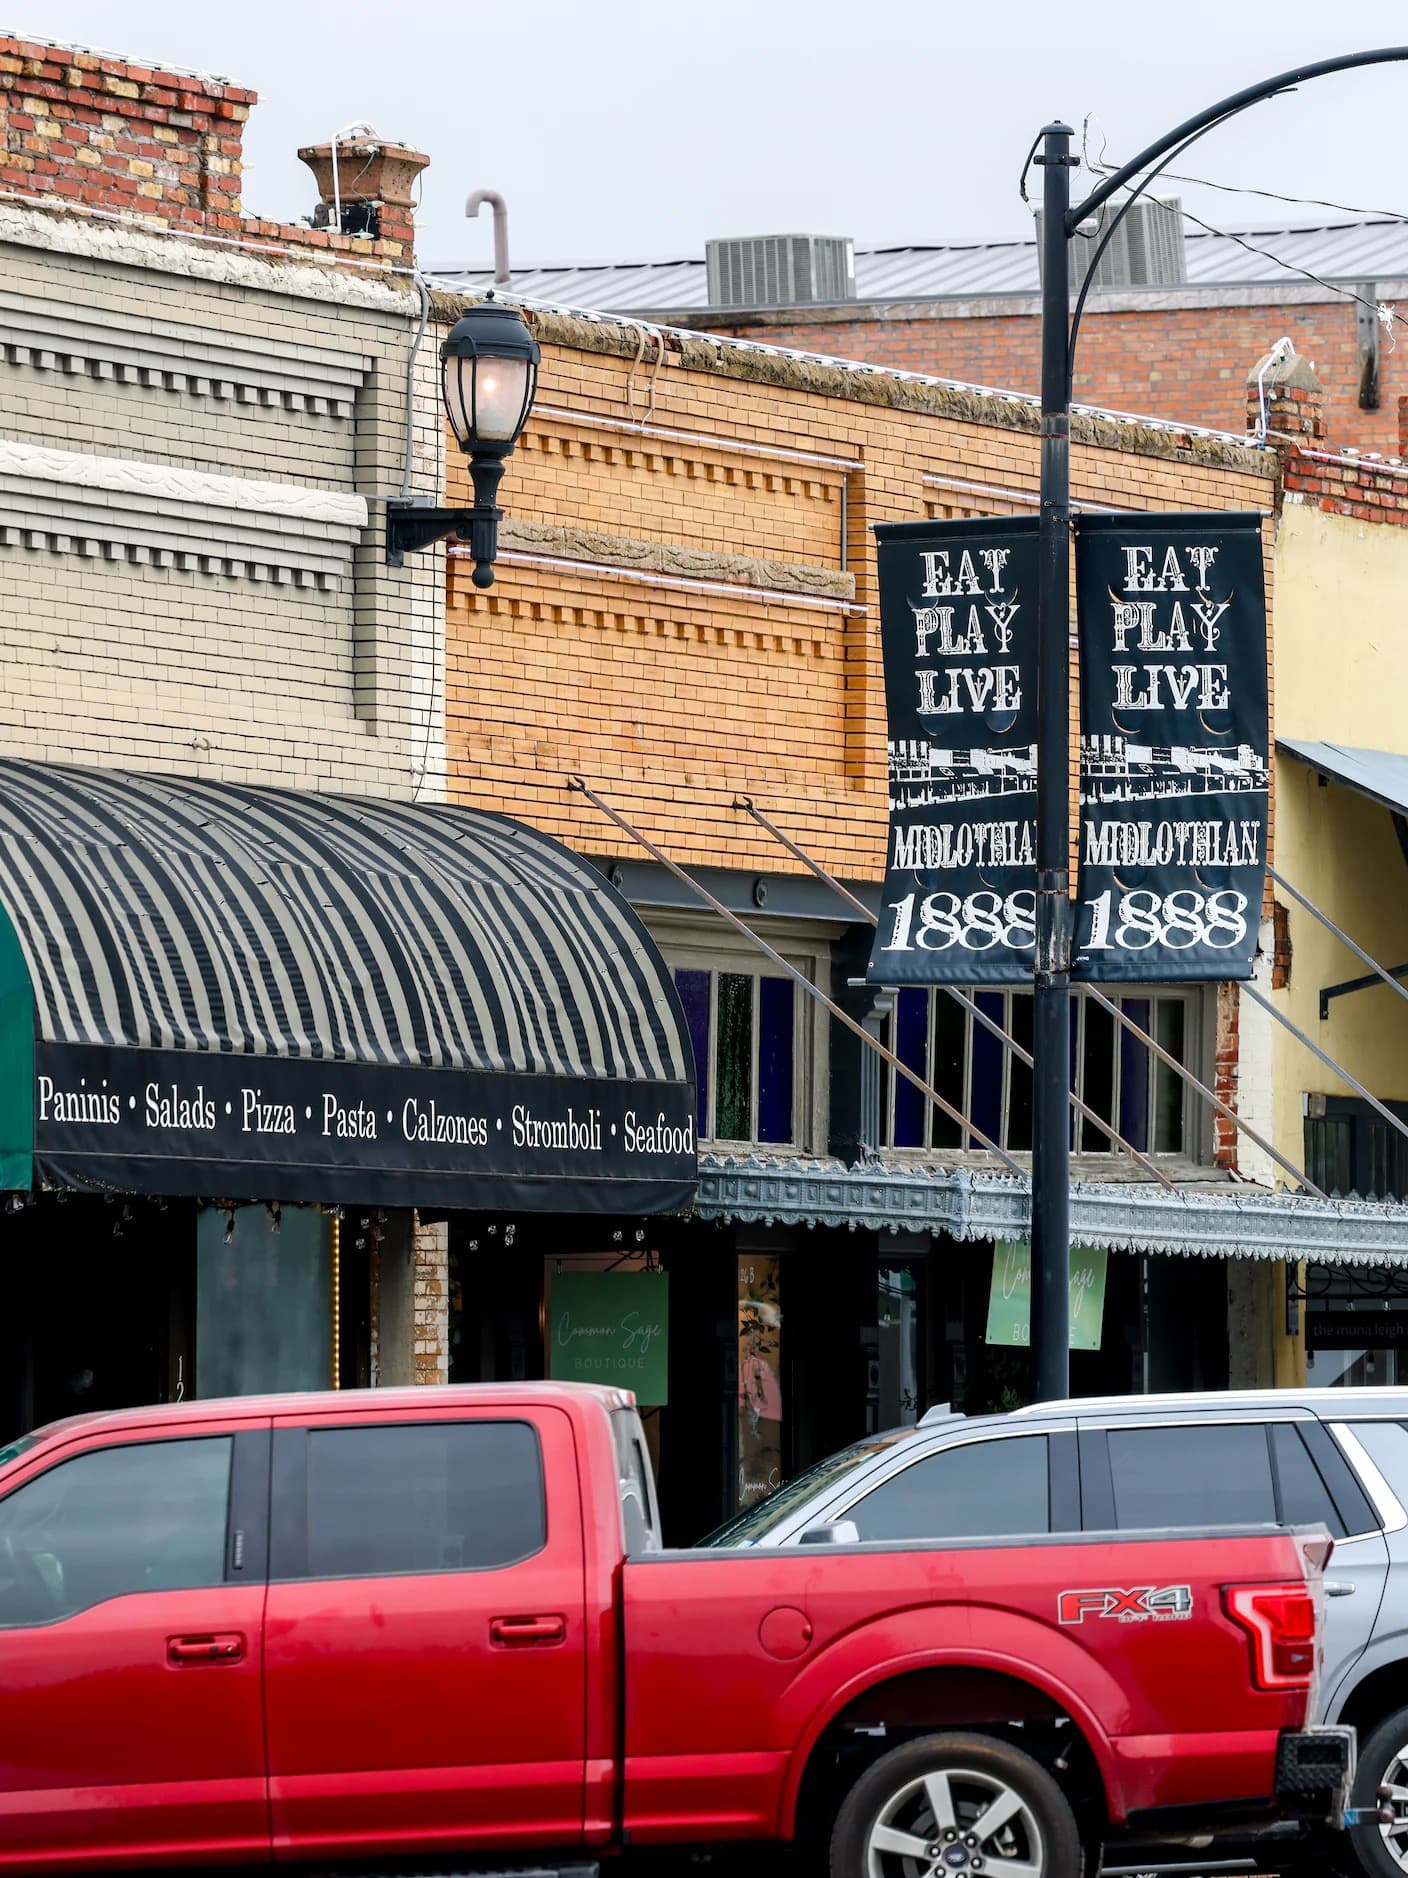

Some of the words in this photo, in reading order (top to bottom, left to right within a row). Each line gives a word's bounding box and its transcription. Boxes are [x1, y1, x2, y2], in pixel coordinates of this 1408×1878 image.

[920, 548, 1010, 597] EAT
[1120, 546, 1219, 592] EAT
[912, 602, 1020, 657] PLAY
[1111, 601, 1230, 652] PLAY
[915, 665, 1021, 714] LIVE
[1111, 664, 1231, 711] LIVE
[891, 822, 1037, 870] MIDLOTHIA
[1082, 819, 1261, 867] MIDLOTHIAN
[880, 890, 1036, 952] 1888
[1079, 889, 1248, 951] 1888
[38, 1076, 120, 1125] Paninis
[145, 1082, 216, 1130] Salads
[241, 1088, 296, 1134] Pizza
[322, 1093, 377, 1140] Pasta
[402, 1098, 488, 1146] Calzones
[512, 1105, 602, 1151] Stromboli
[624, 1110, 695, 1155] Seafood
[557, 1312, 618, 1347] Common
[620, 1311, 664, 1354] Sage
[574, 1357, 647, 1369] BOUTIQUE
[1058, 1585, 1192, 1624] FX4
